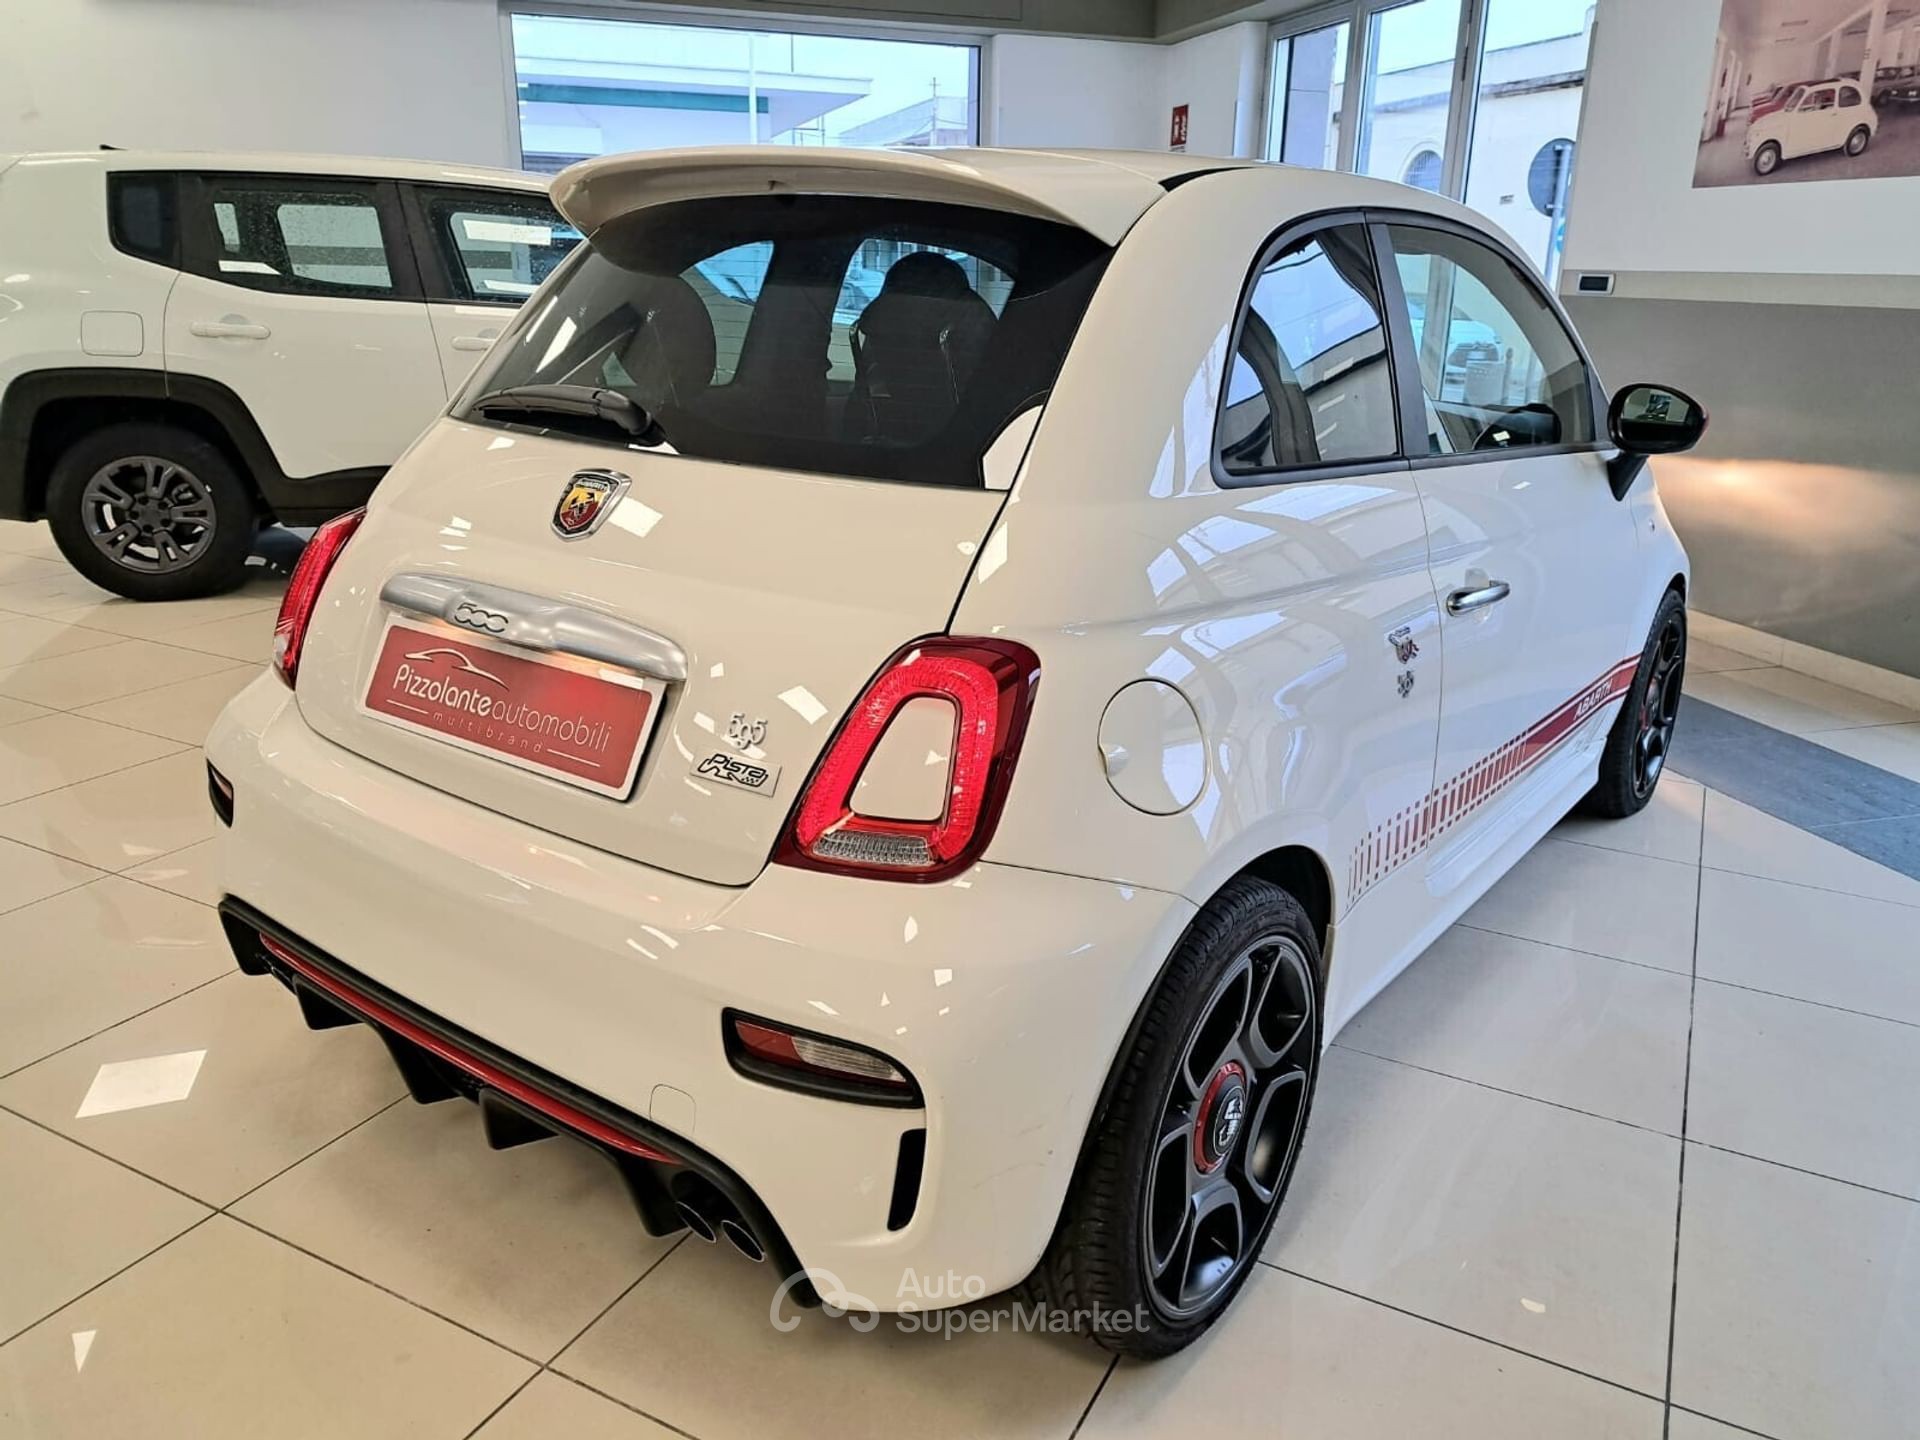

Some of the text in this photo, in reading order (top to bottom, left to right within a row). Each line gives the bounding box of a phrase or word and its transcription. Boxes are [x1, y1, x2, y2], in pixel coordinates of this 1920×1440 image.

[453, 603, 509, 633] 500
[433, 712, 544, 753] multibrand
[729, 713, 768, 750] 595
